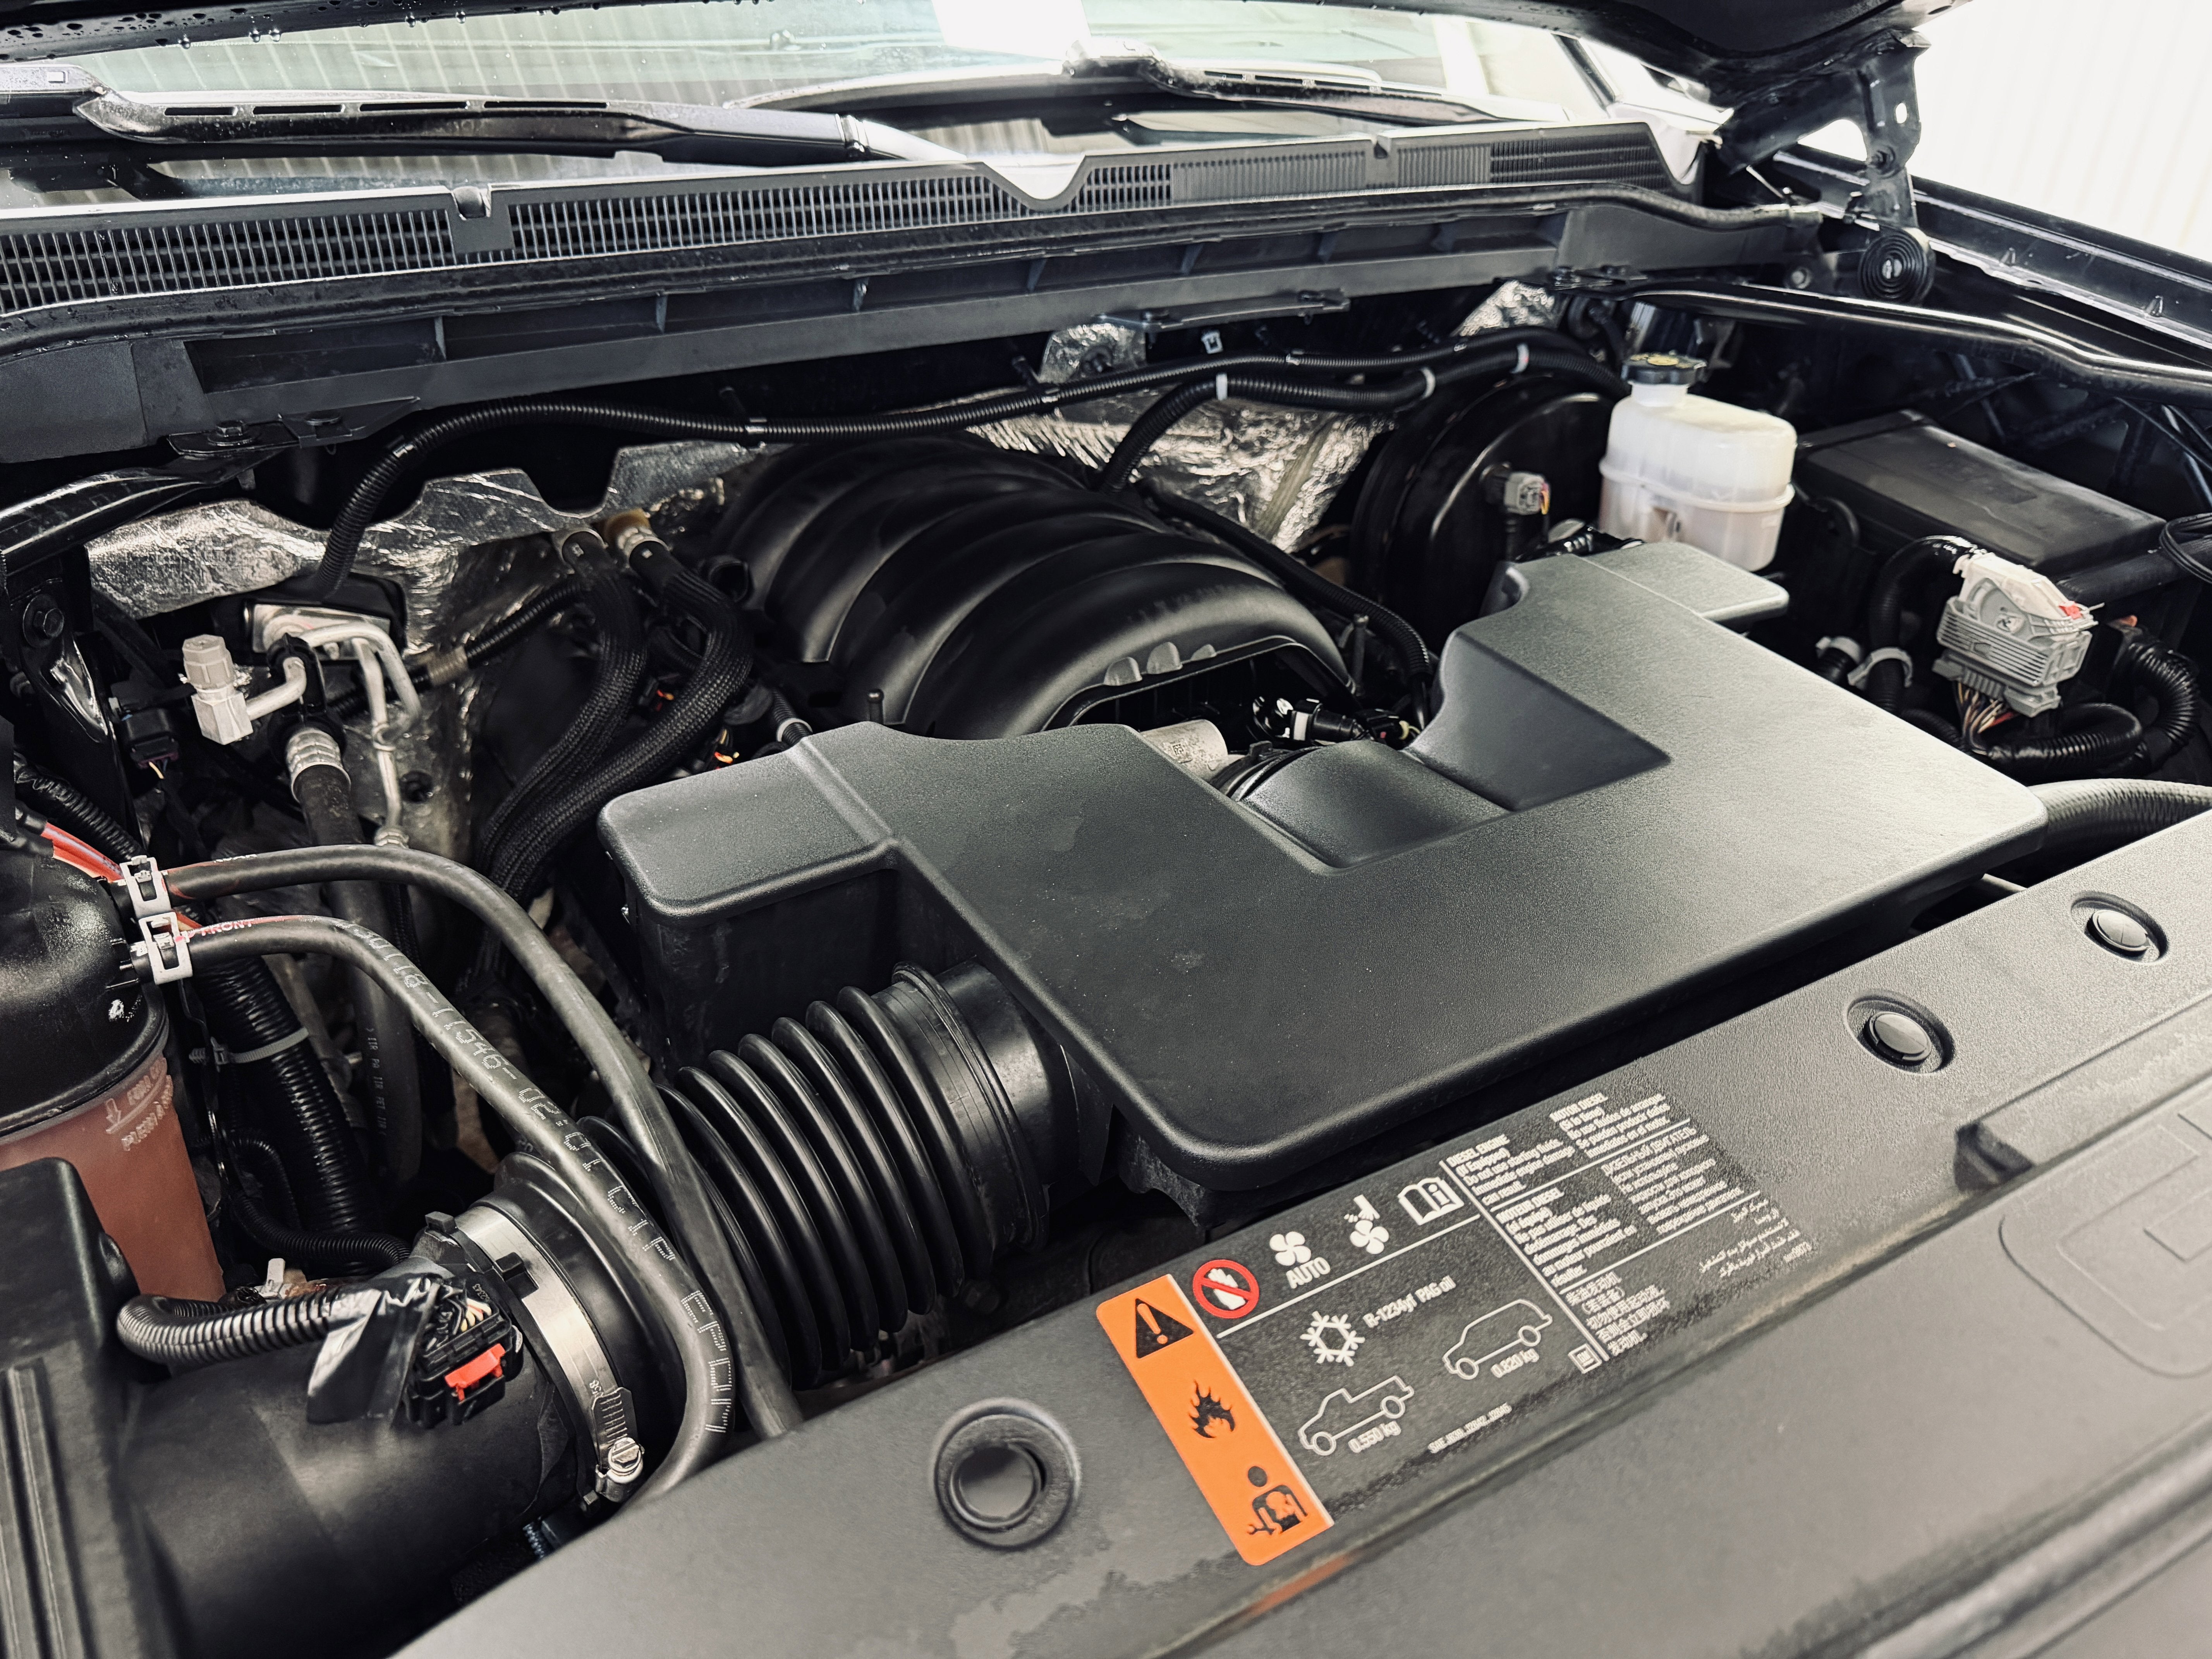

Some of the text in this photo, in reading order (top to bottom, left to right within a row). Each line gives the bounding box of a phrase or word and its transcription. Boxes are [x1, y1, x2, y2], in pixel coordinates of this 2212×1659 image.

[201, 919, 254, 936] FRONT
[1549, 1092, 1608, 1122] MOTOR DIESEL
[1559, 1106, 1609, 1132] (Si lo tiene)
[1567, 1130, 1582, 1140] No
[1580, 1123, 1596, 1135] use
[1620, 1108, 1632, 1117] de
[1630, 1093, 1666, 1113] arranque.
[1576, 1139, 1590, 1149] Se
[1589, 1126, 1618, 1146] pueden
[1616, 1112, 1647, 1133] producir
[1584, 1116, 1670, 1158] inmediatos en el motor.
[1446, 1134, 1510, 1167] DIESEL ENGINE
[1463, 1139, 1563, 1186] Do not use starting fluids.
[1466, 1148, 1510, 1172] Equipped)
[1601, 1127, 1697, 1176] ДИЗЕЛЬНЫЙ ДВИГАТЕЛЬ
[1472, 1146, 1575, 1195] Immediate engine damage
[1664, 1175, 1680, 1188] для
[1482, 1181, 1527, 1206] can result.
[1496, 1187, 1564, 1223] MOTEUR DIESEL
[1618, 1183, 1633, 1195] Не
[1513, 1194, 1611, 1244] Ne pas utiliser de liquide
[1577, 1215, 1597, 1229] Des
[1533, 1218, 1620, 1266] dommages immédiats
[1542, 1224, 1637, 1276] au moteur pourraient en
[1286, 1257, 1331, 1289] AUTO
[1551, 1264, 1587, 1287] résulter.
[1566, 1272, 1622, 1306] 柴油发动机
[1363, 1275, 1456, 1328] R-1234yf PAG oil
[681, 1290, 732, 1433] EPDM
[1491, 1348, 1539, 1377] 0.820 kg
[1348, 1420, 1401, 1453] 0.550 kg
[1428, 1437, 1449, 1453] SAE
